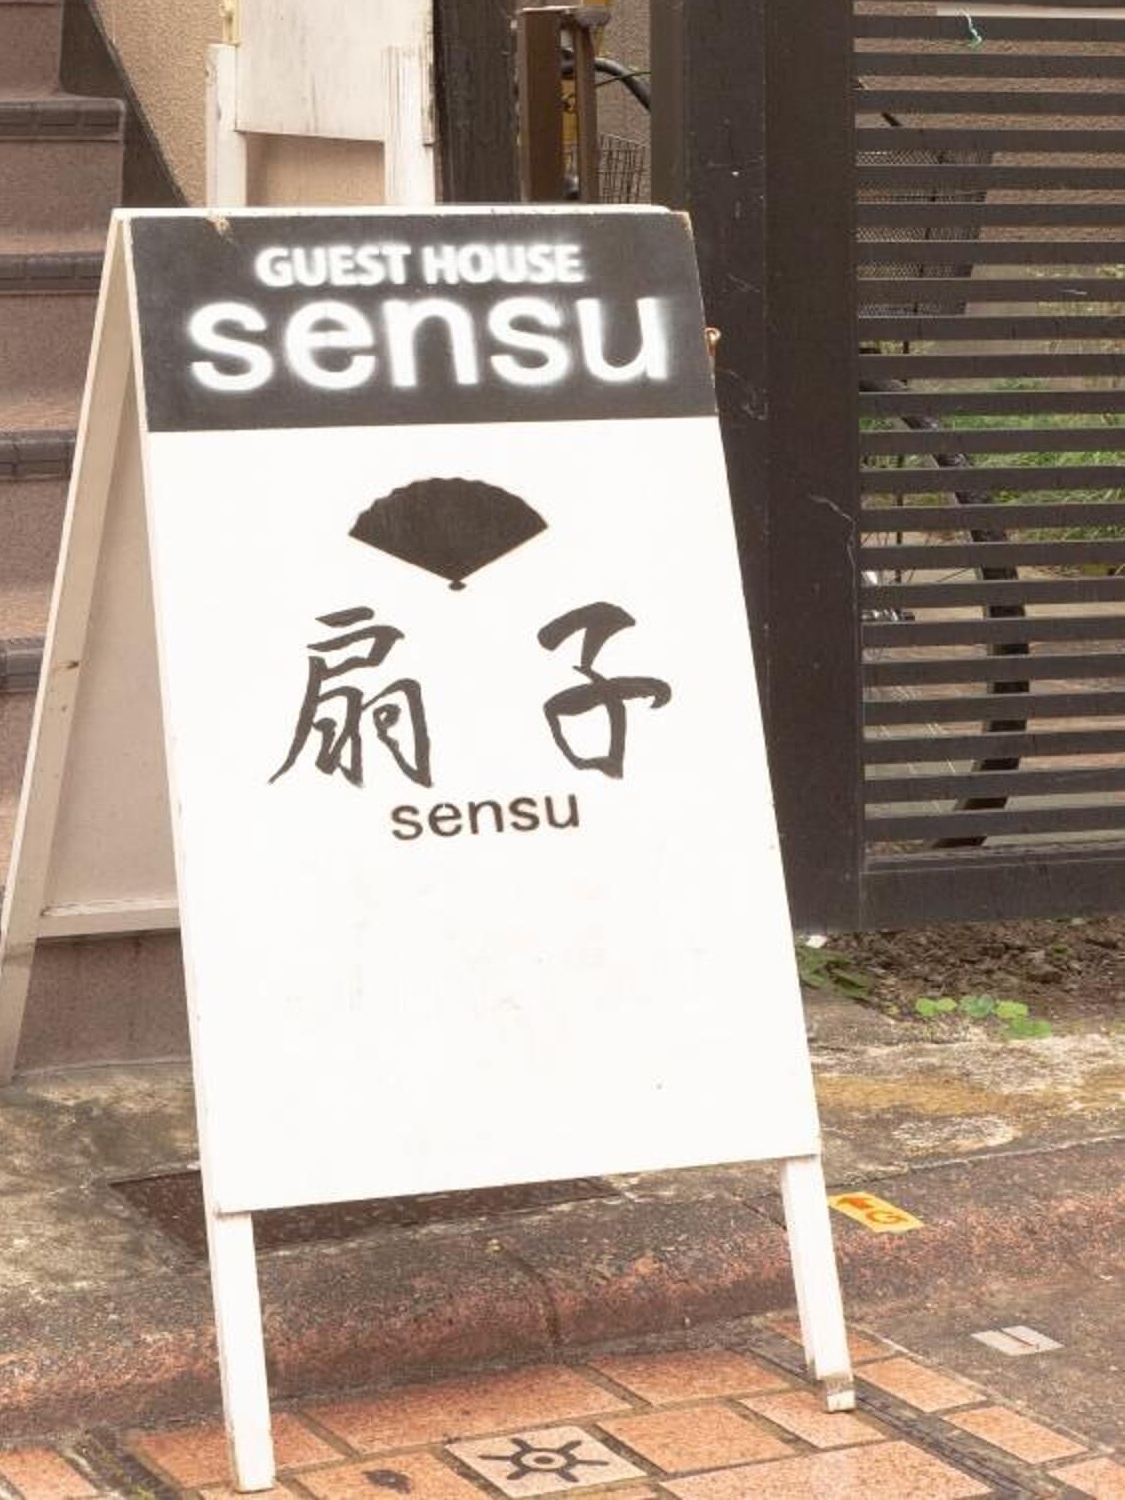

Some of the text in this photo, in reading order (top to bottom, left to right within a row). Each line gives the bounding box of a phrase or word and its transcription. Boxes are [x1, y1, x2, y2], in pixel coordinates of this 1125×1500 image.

[254, 240, 585, 288] GUEST HOUSE
[187, 296, 670, 393] sensu
[268, 601, 672, 788] 扇子
[391, 794, 581, 841] sensu
